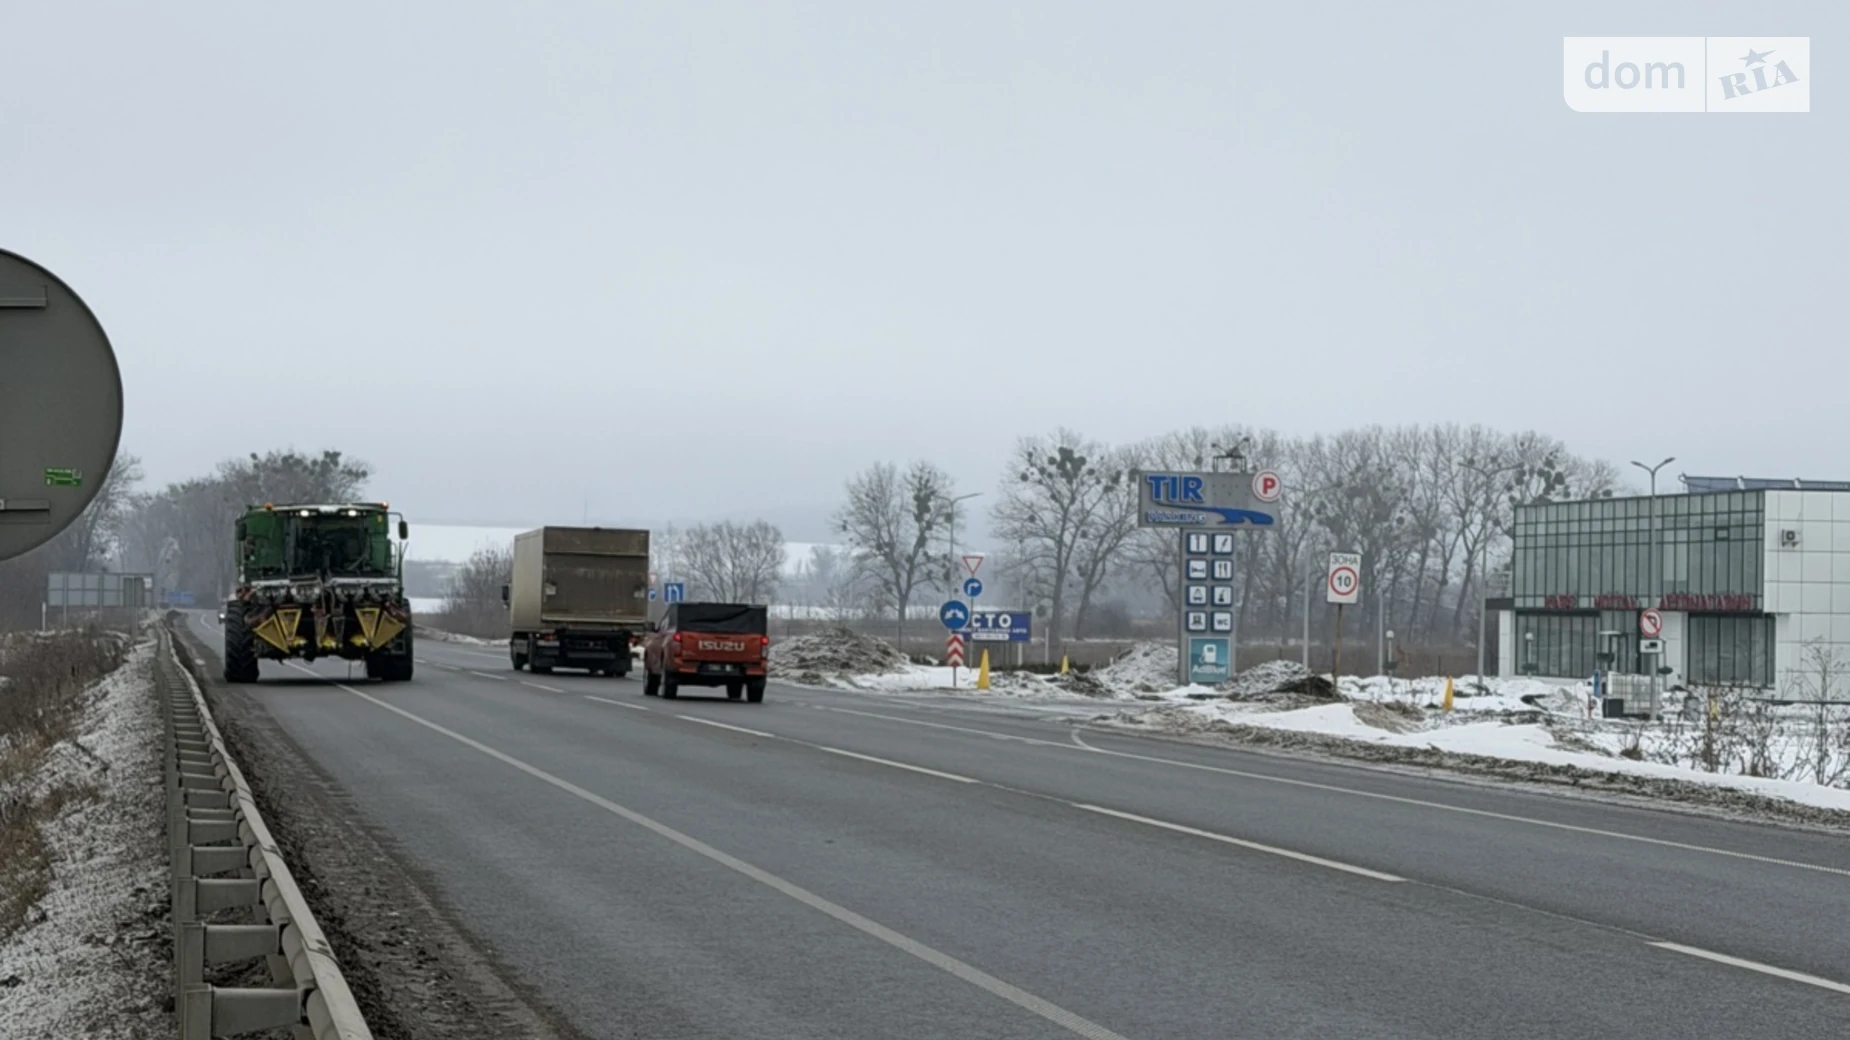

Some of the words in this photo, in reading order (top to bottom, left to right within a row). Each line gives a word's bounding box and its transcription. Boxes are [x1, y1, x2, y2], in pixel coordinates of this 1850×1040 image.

[1147, 475, 1204, 502] TIR
[1262, 477, 1277, 495] P
[1337, 575, 1352, 587] 10
[972, 613, 1012, 628] СТО
[698, 640, 745, 651] ISUZU
